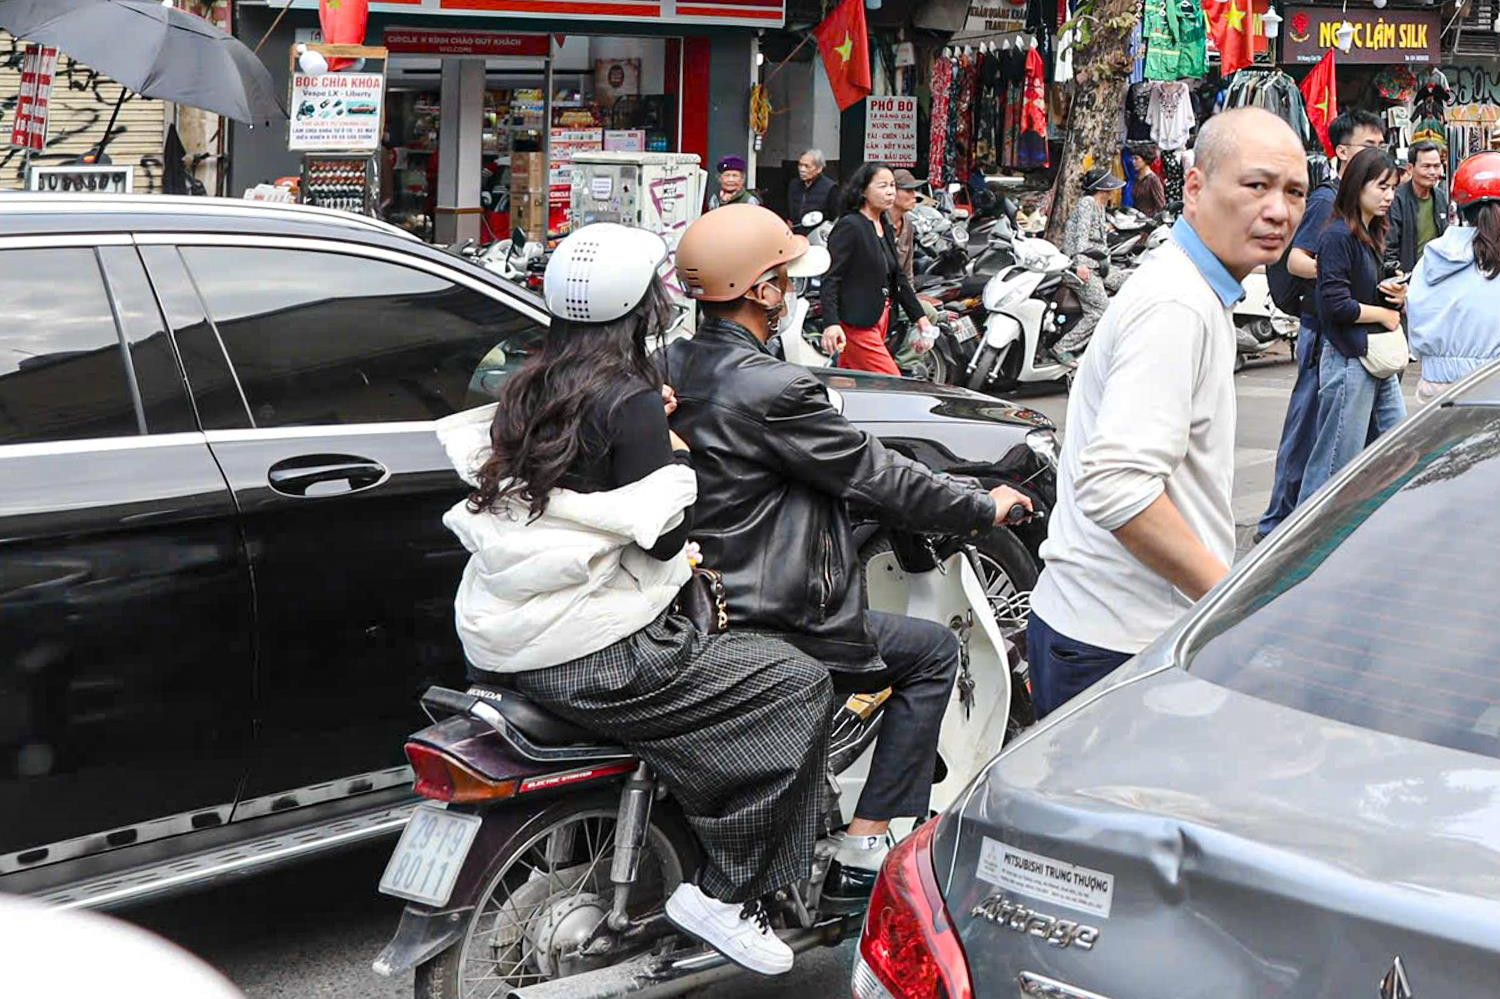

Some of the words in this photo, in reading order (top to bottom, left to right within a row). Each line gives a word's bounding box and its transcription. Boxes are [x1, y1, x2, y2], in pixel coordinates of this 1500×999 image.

[1319, 21, 1363, 53] NGC
[1365, 17, 1396, 51] LÂM
[1398, 23, 1428, 48] SILK
[295, 76, 319, 89] BỌC
[322, 75, 348, 88] CHÌA
[351, 76, 381, 89] KHÓA
[870, 97, 894, 111] PHỞ
[467, 688, 502, 701] HONDA
[391, 851, 450, 897] 8011
[1003, 851, 1044, 875] MITSUBISHI
[1045, 864, 1073, 883] TRUNG
[1073, 872, 1109, 894] THƯỢNG
